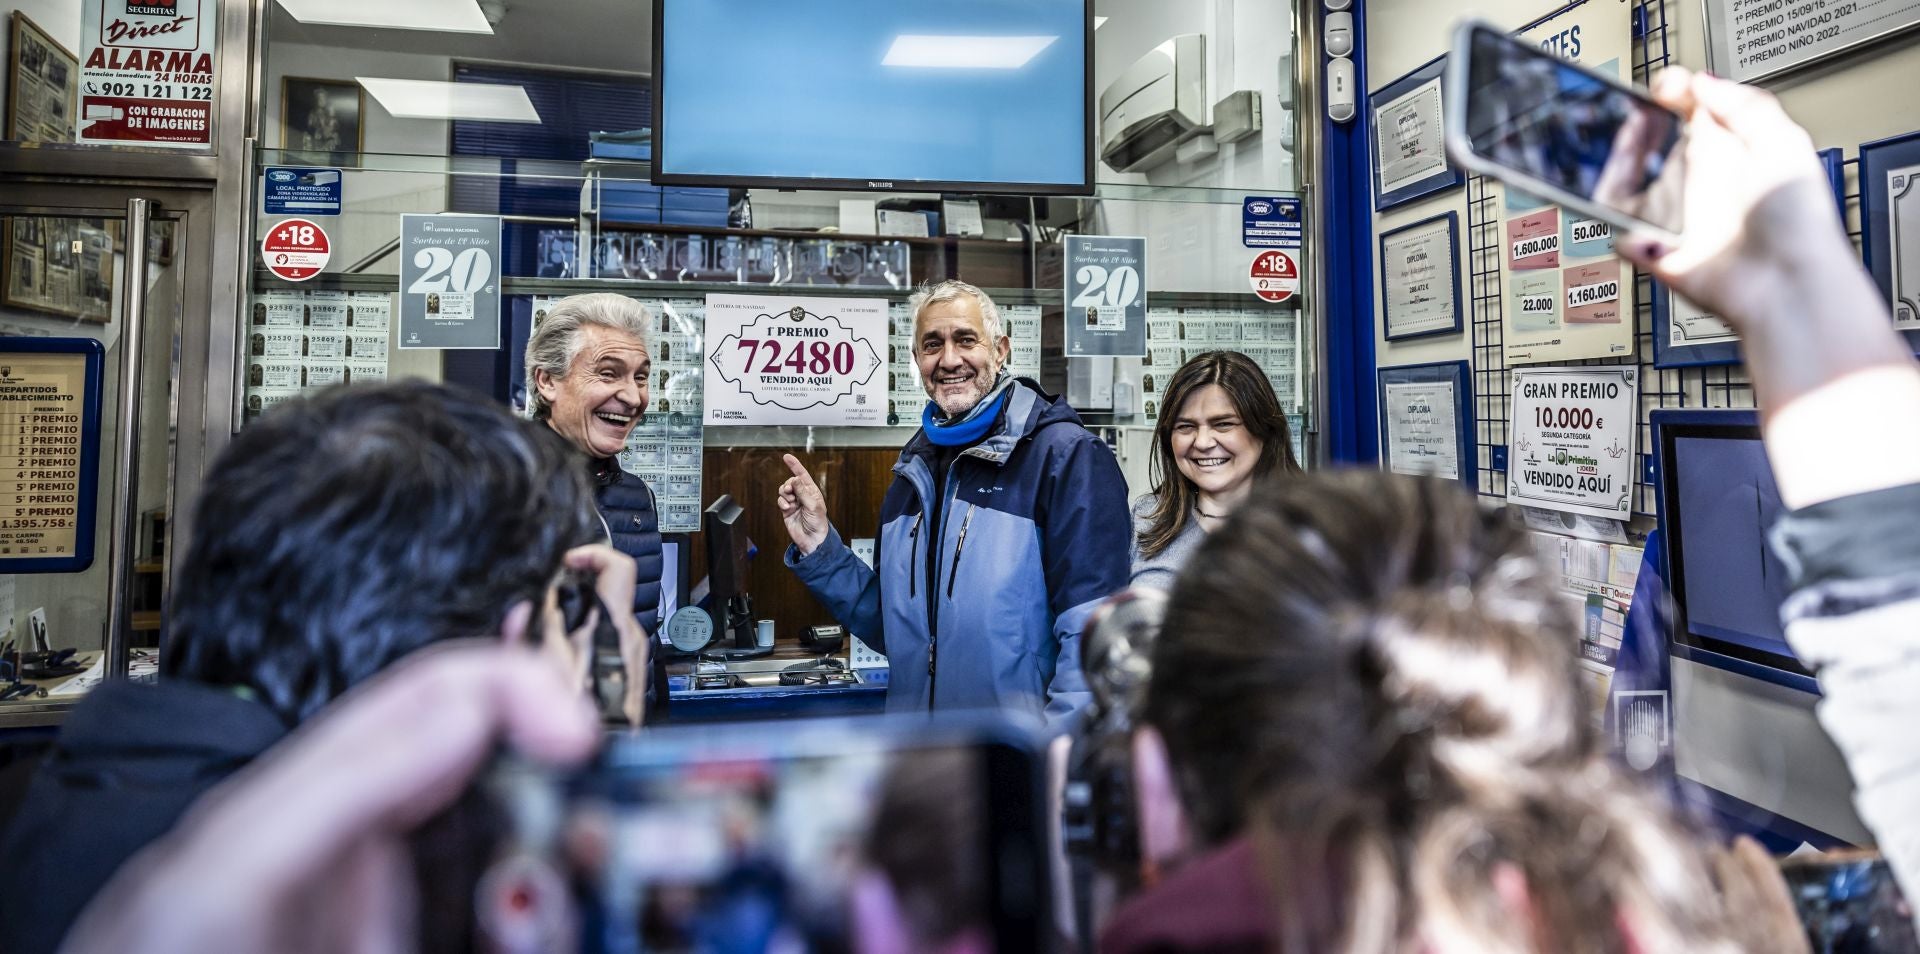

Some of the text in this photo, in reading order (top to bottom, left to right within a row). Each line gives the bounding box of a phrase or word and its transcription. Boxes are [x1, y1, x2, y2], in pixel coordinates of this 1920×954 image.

[128, 6, 175, 15] SECURITAS
[1745, 0, 1783, 22] PREMIO
[1746, 14, 1784, 36] PREMIO
[1787, 1, 1826, 21] 15/09/16
[105, 15, 194, 43] Direct
[1748, 28, 1786, 50] PREMIO
[1787, 12, 1832, 36] NAVIDAD
[1834, 2, 1858, 19] 2021
[1539, 24, 1581, 58] OTES
[1749, 43, 1787, 65] PREMIO
[1788, 34, 1814, 52] NIÑO
[1816, 25, 1841, 42] 2022
[84, 48, 213, 74] ALARMA
[154, 73, 170, 82] 24
[174, 74, 212, 84] HORAS
[102, 82, 212, 100] 902 121 122
[128, 106, 206, 119] CON GRABACION
[128, 117, 205, 131] DE IMAGENES
[278, 226, 315, 246] +18
[1574, 223, 1608, 240] 50.000
[1513, 236, 1558, 256] 1.600.000
[1260, 255, 1287, 272] +18
[1406, 252, 1428, 264] DIPLOMA
[407, 247, 494, 294] 20 €
[1071, 265, 1140, 308] 20
[1568, 282, 1617, 304] 1.160.000
[1522, 298, 1552, 311] 22.000
[777, 326, 829, 338] PREMIO
[737, 339, 855, 376] 72480
[760, 375, 833, 385] VENDIDO AQUÍ
[1524, 383, 1619, 399] GRAN PREMIO
[1408, 405, 1431, 414] DIPLOMA
[1535, 406, 1603, 429] 10.000 €
[33, 415, 78, 423] PREMIO
[32, 426, 77, 434] PREMIO
[1563, 432, 1591, 440] CATEGORÍA
[32, 436, 77, 444] PREMIO
[1548, 454, 1598, 466] La Primitiva
[30, 483, 75, 491] PREMIO
[1524, 470, 1574, 489] VENDIDO
[1578, 475, 1612, 494] AQUÍ
[29, 495, 74, 503] PREMIO
[29, 508, 74, 516] PREMIO
